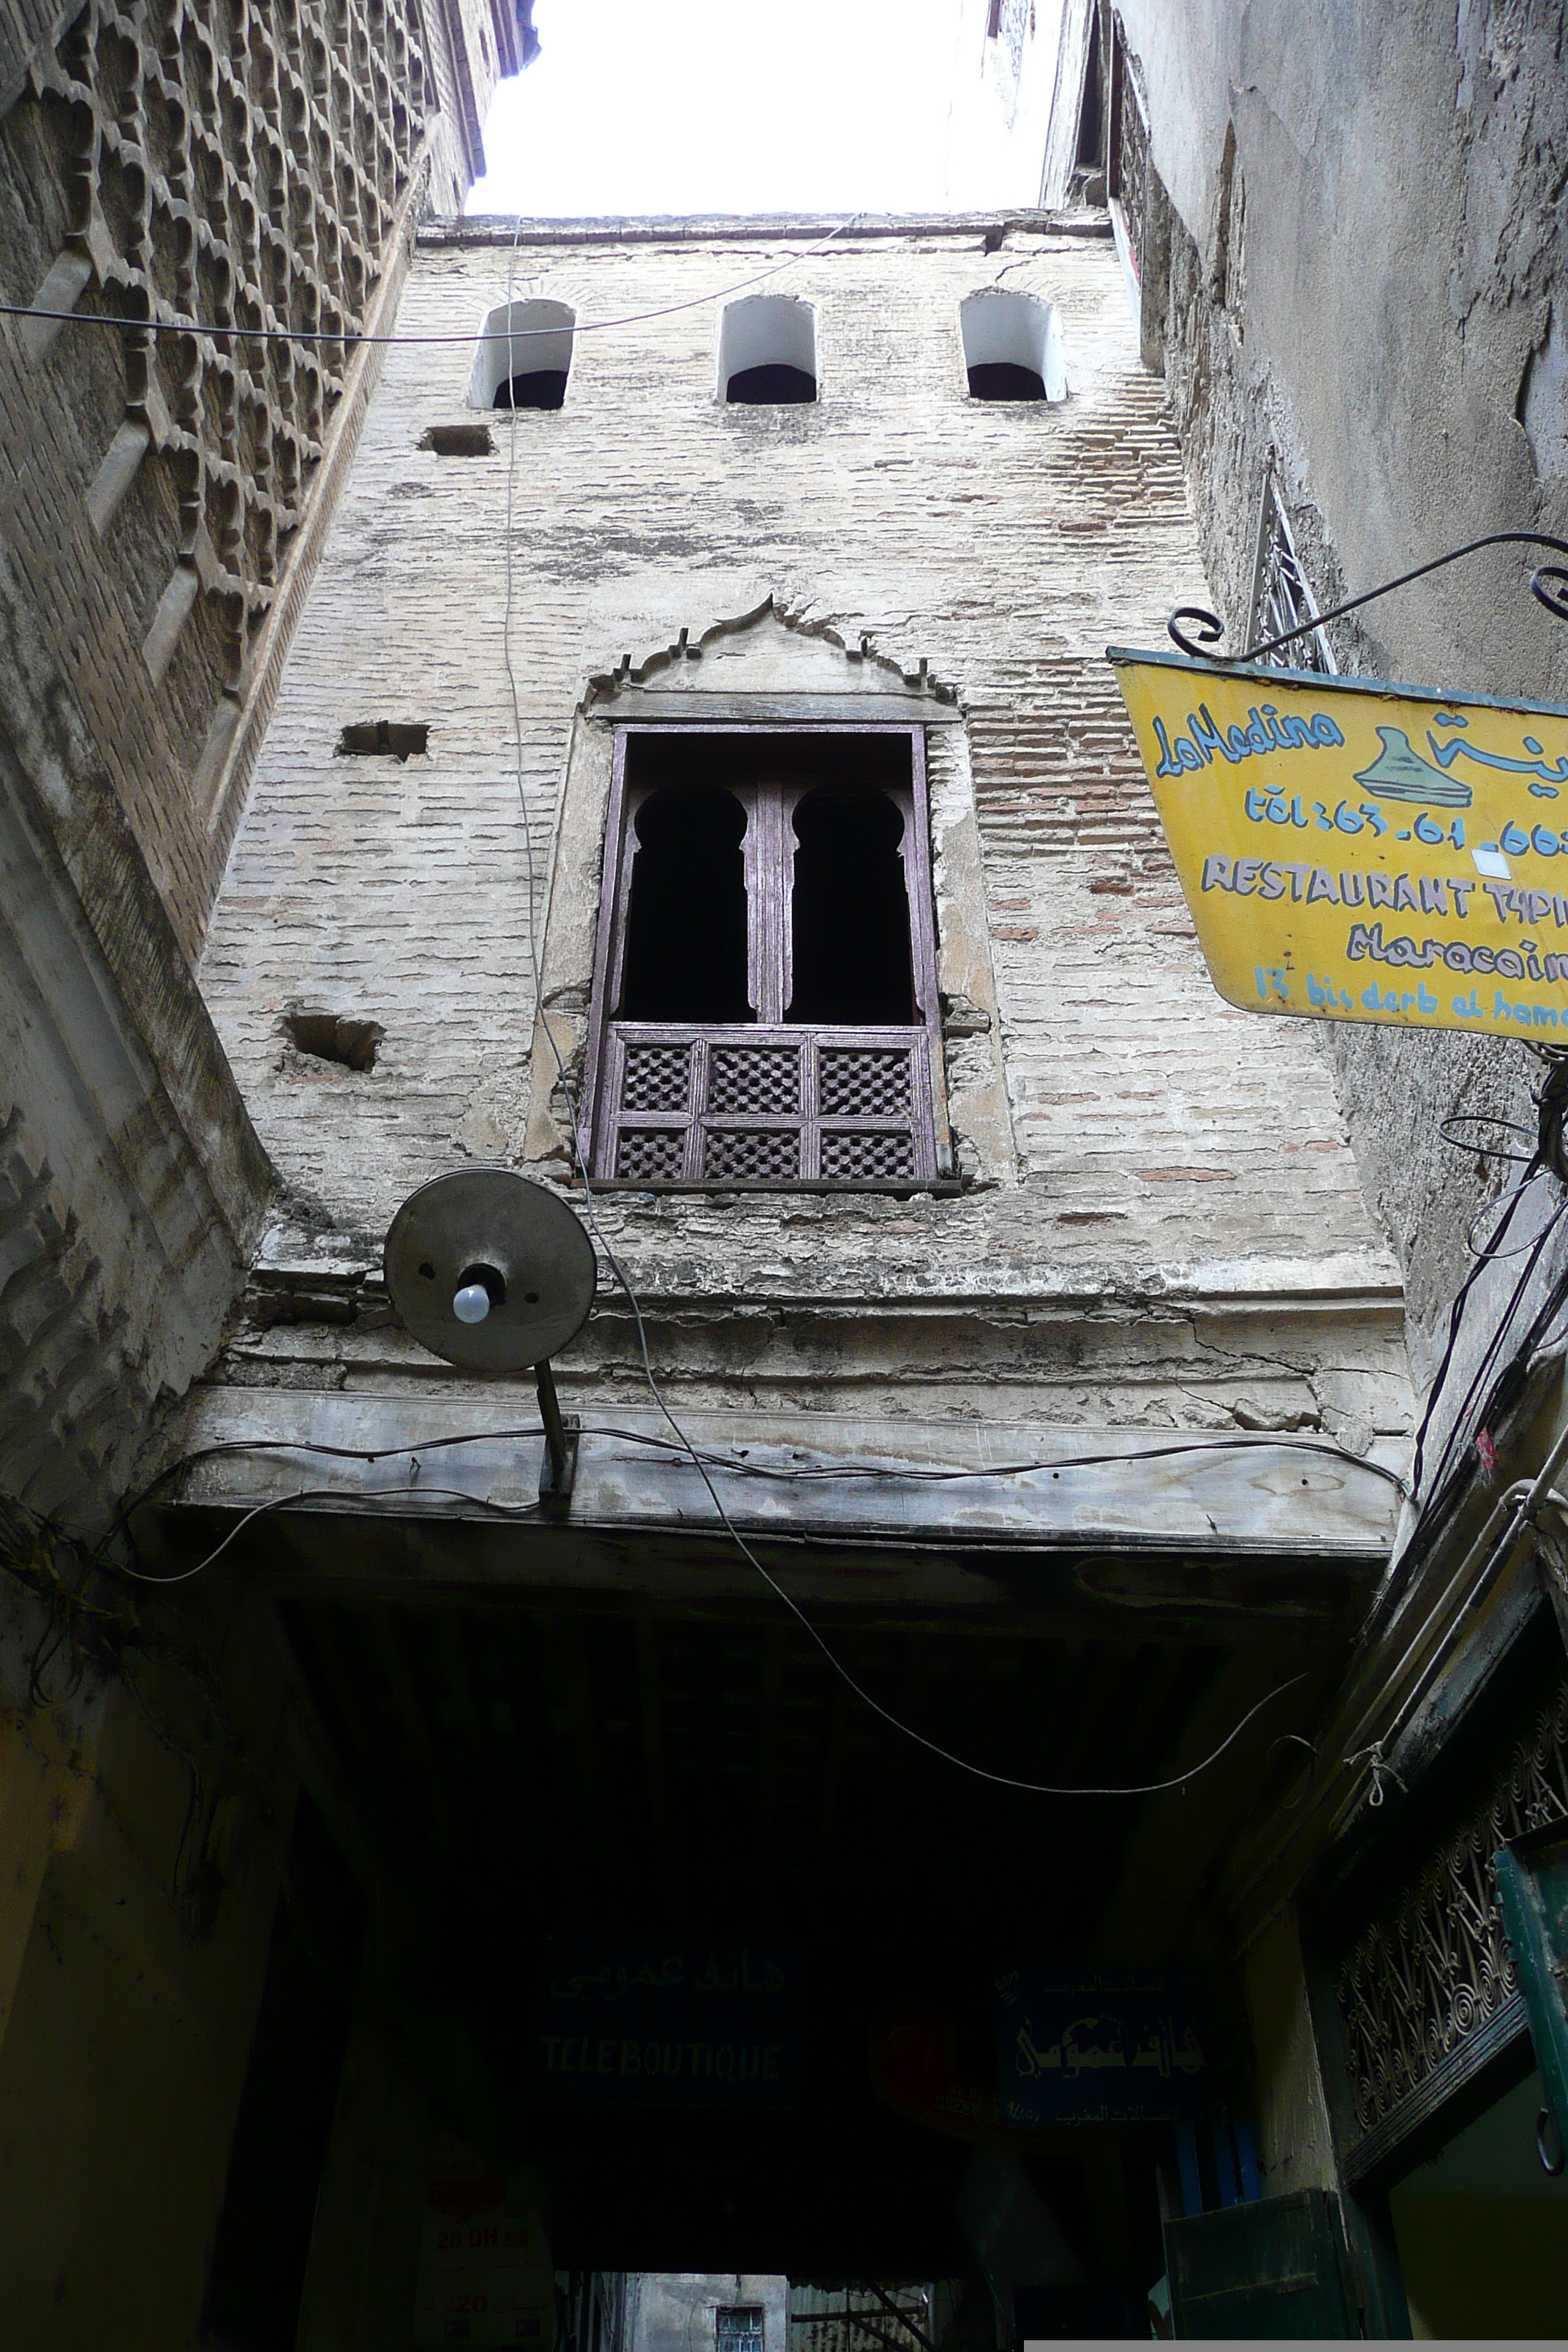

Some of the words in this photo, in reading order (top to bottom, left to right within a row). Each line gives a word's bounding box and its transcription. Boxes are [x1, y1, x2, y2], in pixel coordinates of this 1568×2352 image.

[1202, 854, 1476, 919] RESTAURANT
[1482, 881, 1568, 929] TYPI
[1254, 966, 1289, 1001] 13
[1306, 973, 1354, 1010] bis
[1360, 981, 1439, 1014] derb
[540, 2035, 783, 2084] TELEBOUTIQUE
